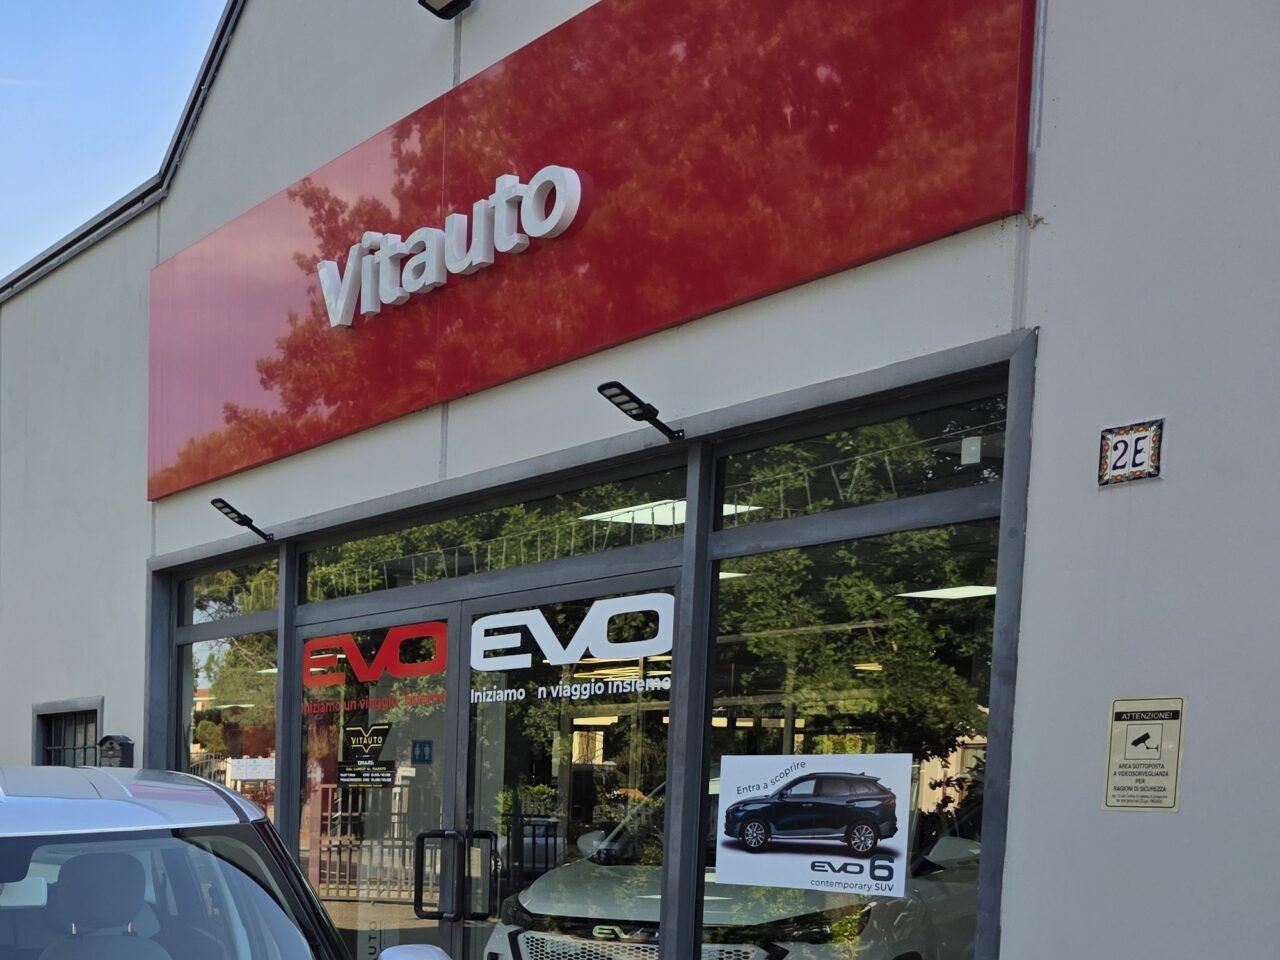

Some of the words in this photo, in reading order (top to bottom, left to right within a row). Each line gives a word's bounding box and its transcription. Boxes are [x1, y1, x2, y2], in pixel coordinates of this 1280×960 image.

[317, 165, 582, 328] Vitauto
[1112, 435, 1148, 470] 2E
[471, 592, 675, 671] EVO
[303, 621, 449, 687] EVO
[470, 685, 526, 704] Iniziamo
[550, 679, 605, 700] viaggio
[608, 675, 672, 694] insieme
[1121, 712, 1173, 720] ATTENZIONE!
[736, 784, 761, 795] Entra
[770, 761, 807, 786] scoprire
[810, 861, 865, 875] EVO
[869, 855, 894, 881] 6
[810, 879, 873, 892] contemporary
[874, 882, 895, 892] SUV
